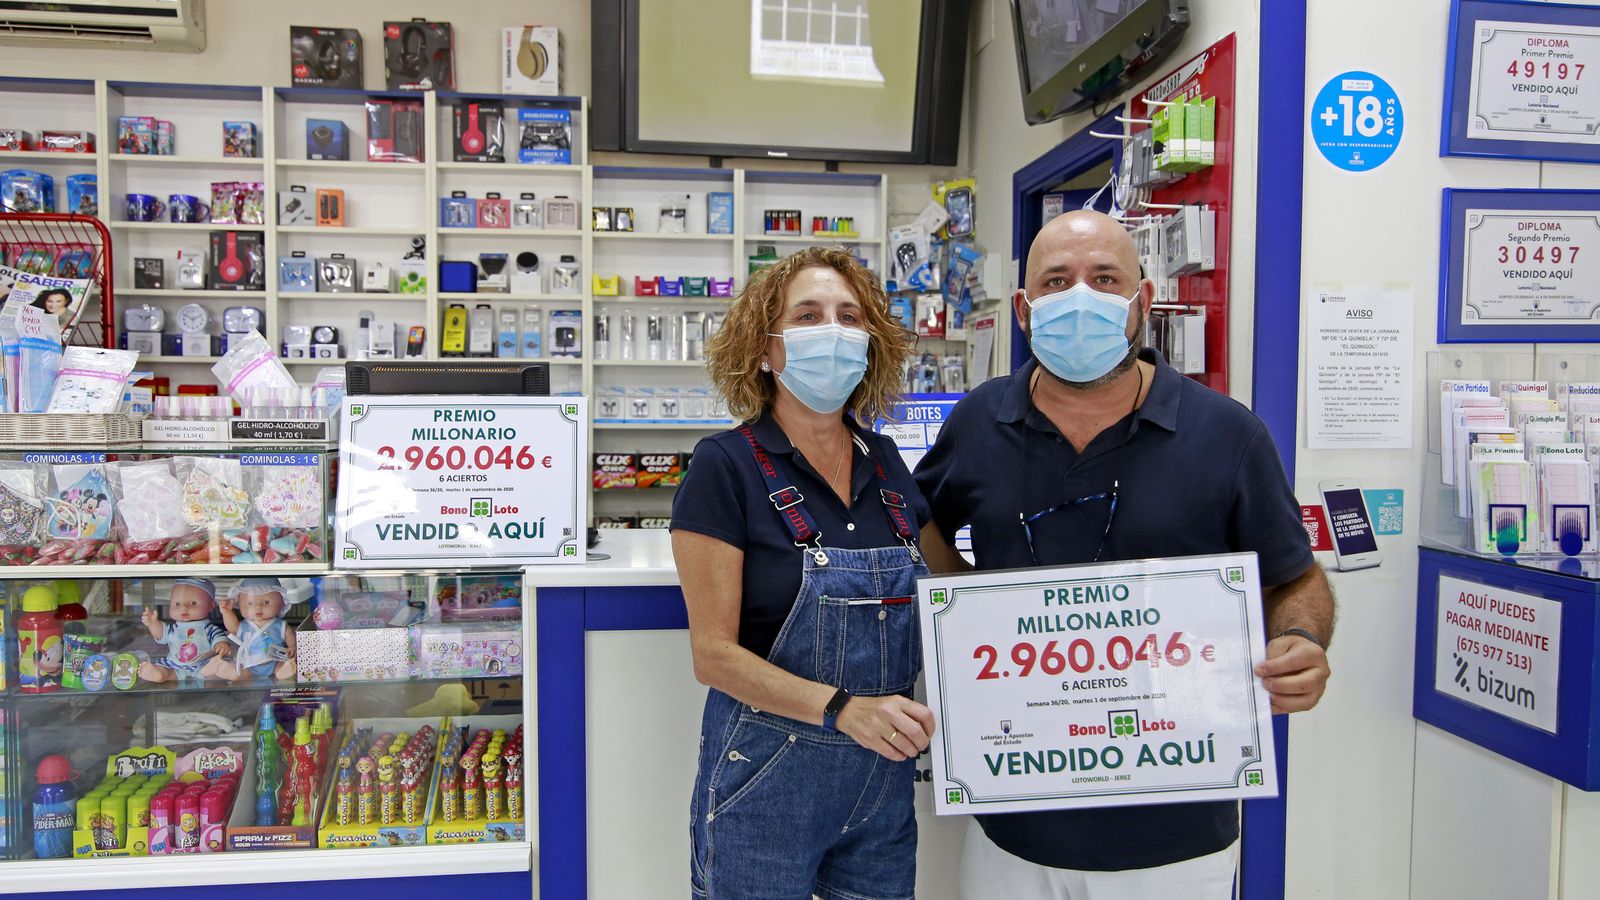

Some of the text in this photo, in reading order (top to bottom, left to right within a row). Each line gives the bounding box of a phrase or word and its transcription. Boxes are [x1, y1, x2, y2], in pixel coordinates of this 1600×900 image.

[1527, 38, 1569, 48] DIPLOMA
[1521, 48, 1574, 59] Primer Premio
[1512, 84, 1578, 95] VENDIDO AQUÍ
[1320, 95, 1384, 137] +18
[1385, 98, 1394, 136] AÑOS
[1518, 222, 1562, 231] DIPLOMA
[1508, 234, 1570, 244] Segundo Premio
[1503, 268, 1573, 280] VENDIDO AQUÍ
[19, 274, 74, 288] SABER
[1346, 309, 1373, 318] AVISO
[1454, 384, 1489, 392] Con Partidos
[1518, 384, 1548, 392] Quinigol
[433, 409, 496, 422] PREMIO
[907, 407, 942, 420] BOTES
[252, 422, 320, 430] HIDRO-ALCOHÓLICO
[411, 427, 516, 441] MILLONARIO
[26, 454, 82, 463] GOMINOLAS
[99, 454, 104, 462] €
[242, 456, 295, 464] GOMINOLAS
[312, 456, 318, 464] €
[541, 455, 552, 469] €
[439, 474, 488, 482] 6 ACIERTOS
[440, 504, 519, 515] Bono Loto
[488, 517, 546, 540] AQUÍ
[1044, 584, 1130, 606] PREMIO
[1458, 592, 1536, 622] AQUÍ PUEDES
[1017, 608, 1160, 635] MILLONARIO
[1446, 610, 1549, 651] PAGAR MEDIANTE
[972, 632, 1216, 680] 2.960.046 €
[1457, 636, 1532, 674] (675 977 513)
[1062, 678, 1128, 691] 6 ACIERTOS
[1478, 666, 1534, 710] bizum
[1026, 700, 1049, 708] Semana
[1108, 694, 1141, 703] septiembre
[1068, 718, 1176, 736] Bono Loto
[984, 734, 1216, 776] VENDIDO AQUÍ
[114, 754, 167, 778] Brain
[326, 833, 377, 843] Lacasitos
[434, 829, 485, 840] Lacasitos
